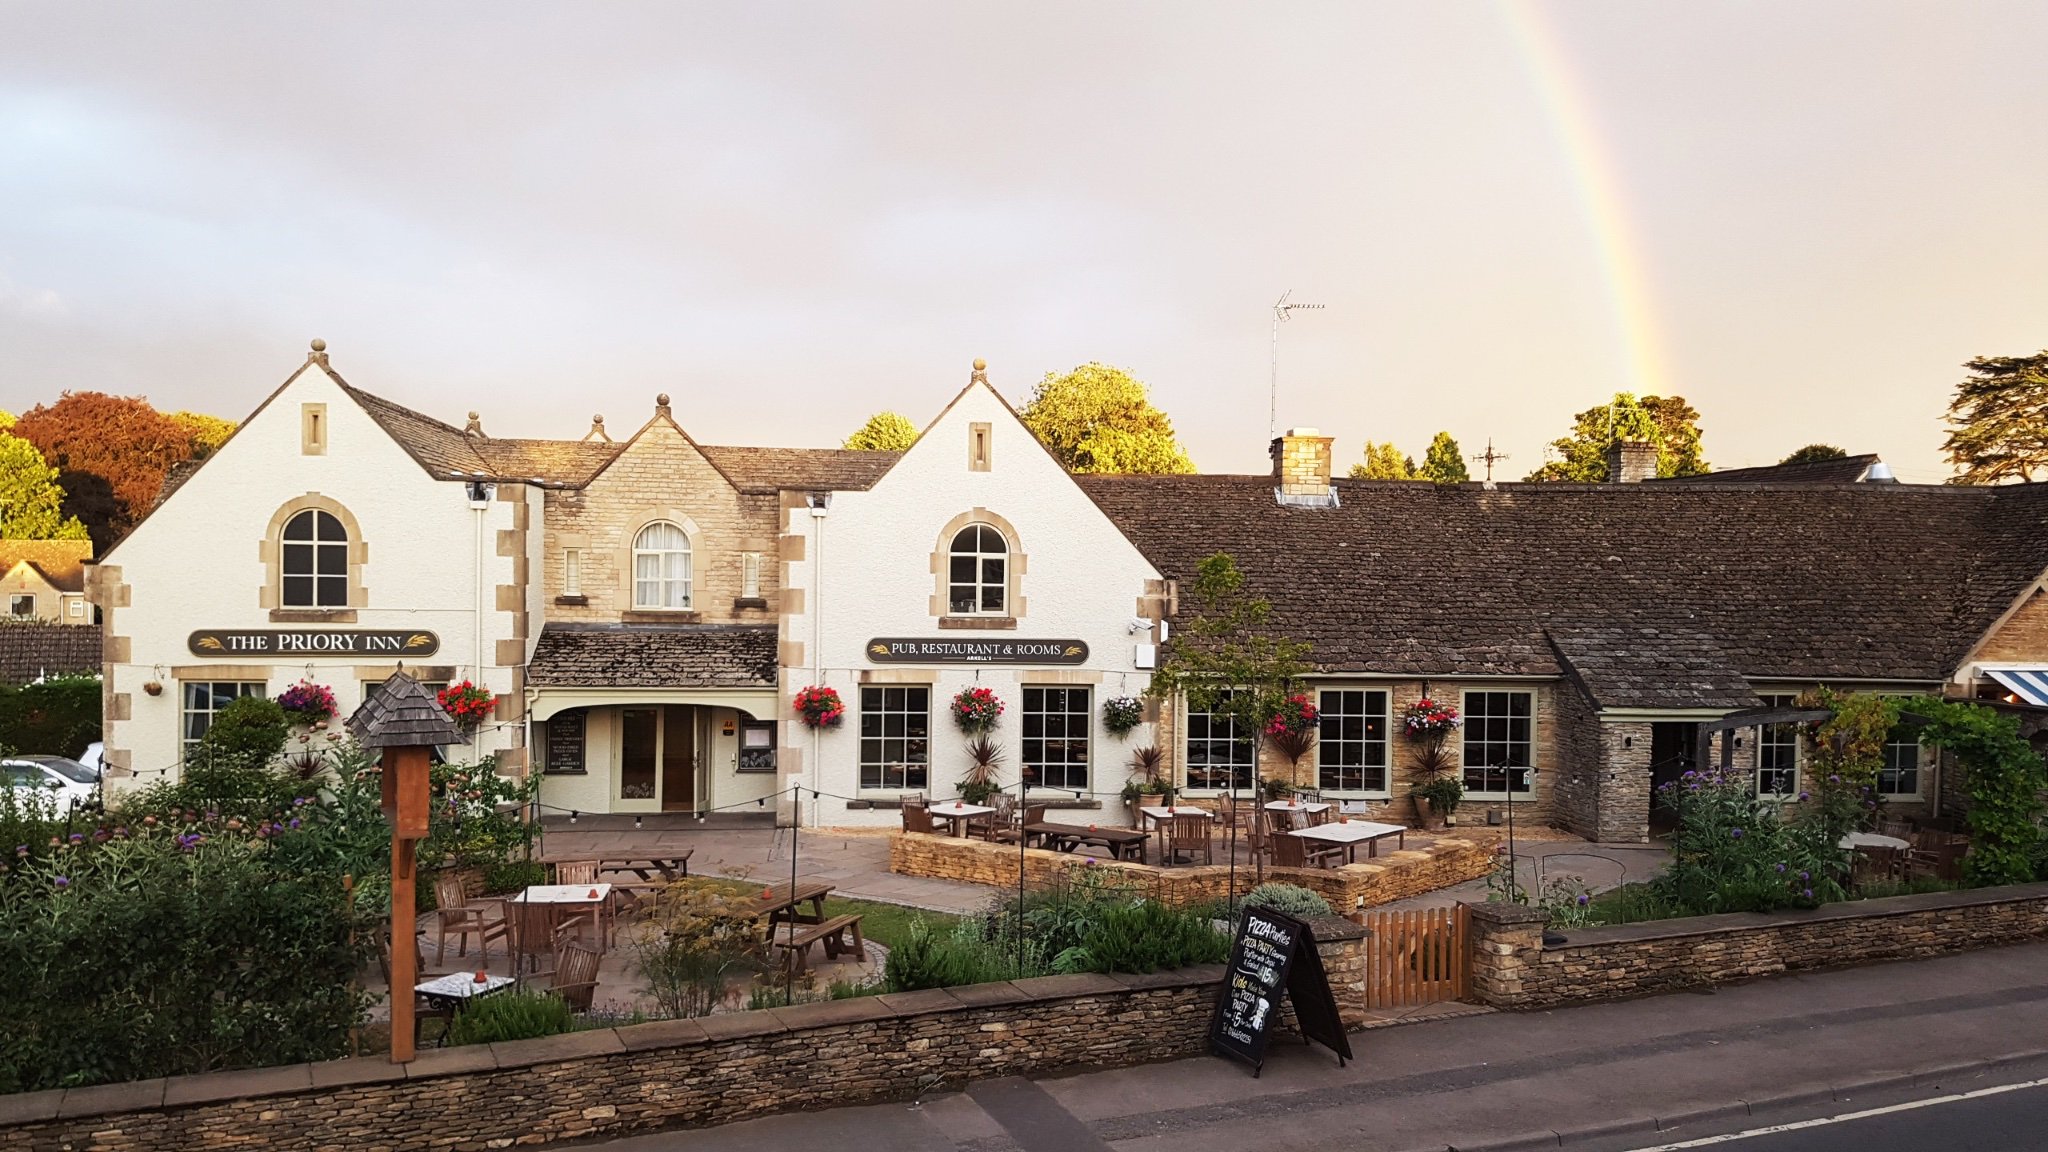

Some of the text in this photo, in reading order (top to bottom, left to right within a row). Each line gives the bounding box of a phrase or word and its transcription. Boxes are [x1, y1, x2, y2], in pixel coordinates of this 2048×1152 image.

[227, 634, 402, 650] THE PRIORY INN
[891, 643, 1061, 655] PUB, RESTAURANT & ROOMS
[1248, 917, 1291, 945] PIZZA Parties
[1243, 935, 1257, 949] PIZZA
[1257, 940, 1275, 955] PARTY
[1232, 973, 1248, 989] Kids
[1240, 990, 1256, 1004] PIZZA
[1233, 999, 1249, 1013] PARTY
